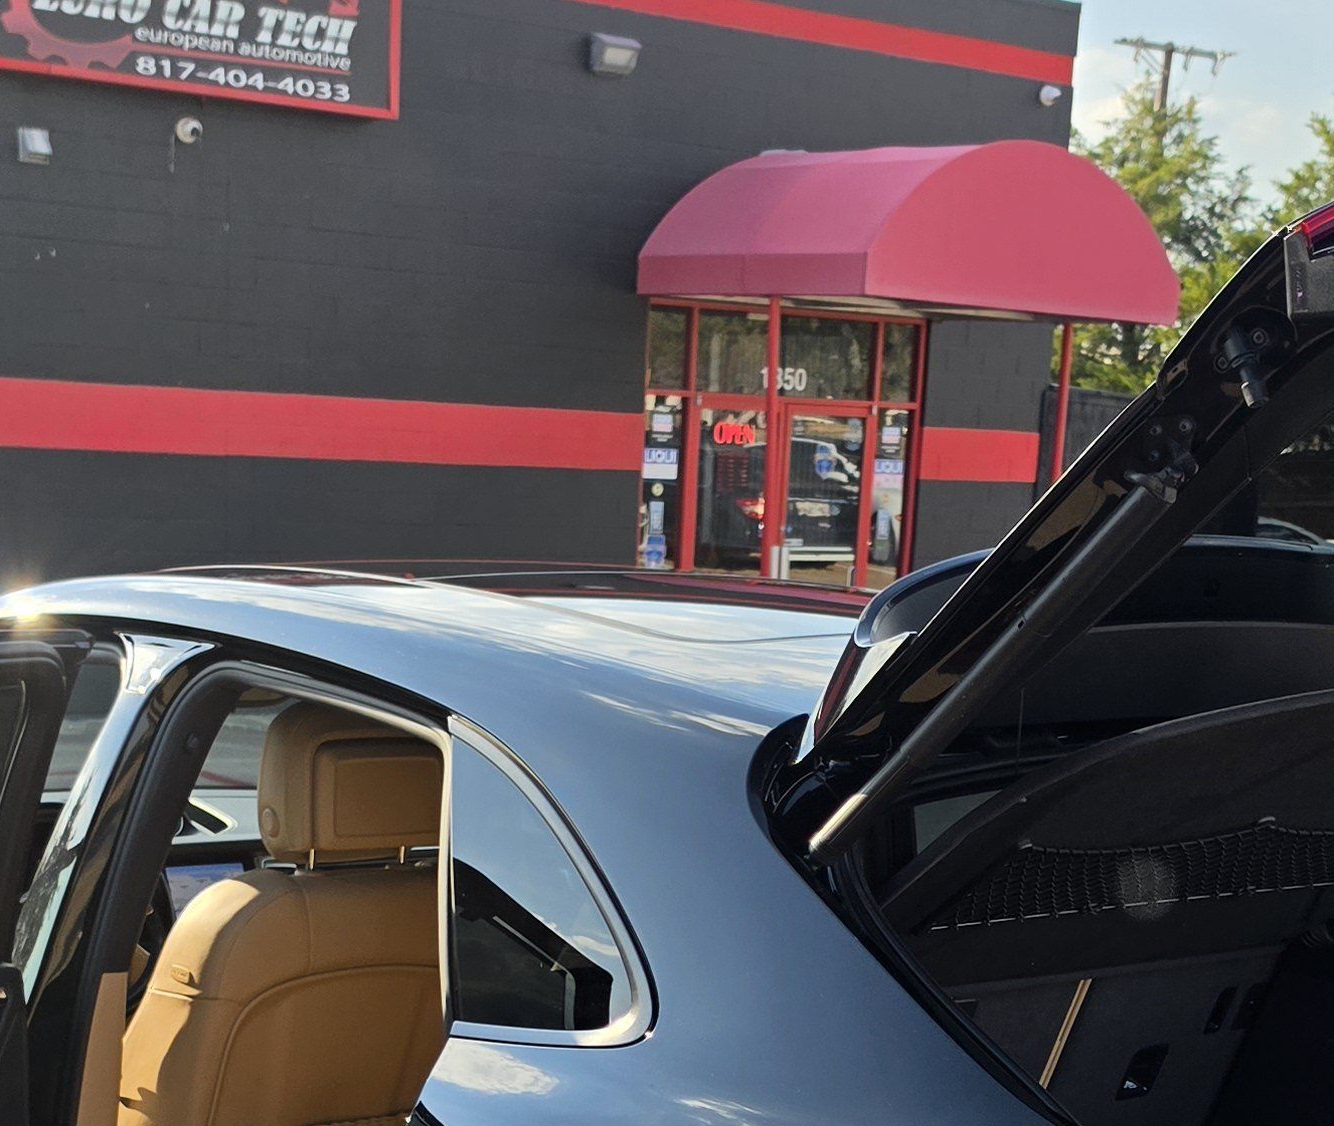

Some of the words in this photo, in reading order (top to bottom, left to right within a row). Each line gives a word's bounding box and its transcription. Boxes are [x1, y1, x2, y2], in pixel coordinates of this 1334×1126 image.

[134, 26, 235, 53] european
[237, 41, 352, 71] automotive
[161, 0, 246, 39] CAR
[255, 7, 358, 55] TECH
[135, 55, 351, 102] 817-404-4033
[714, 421, 755, 445] OPEN
